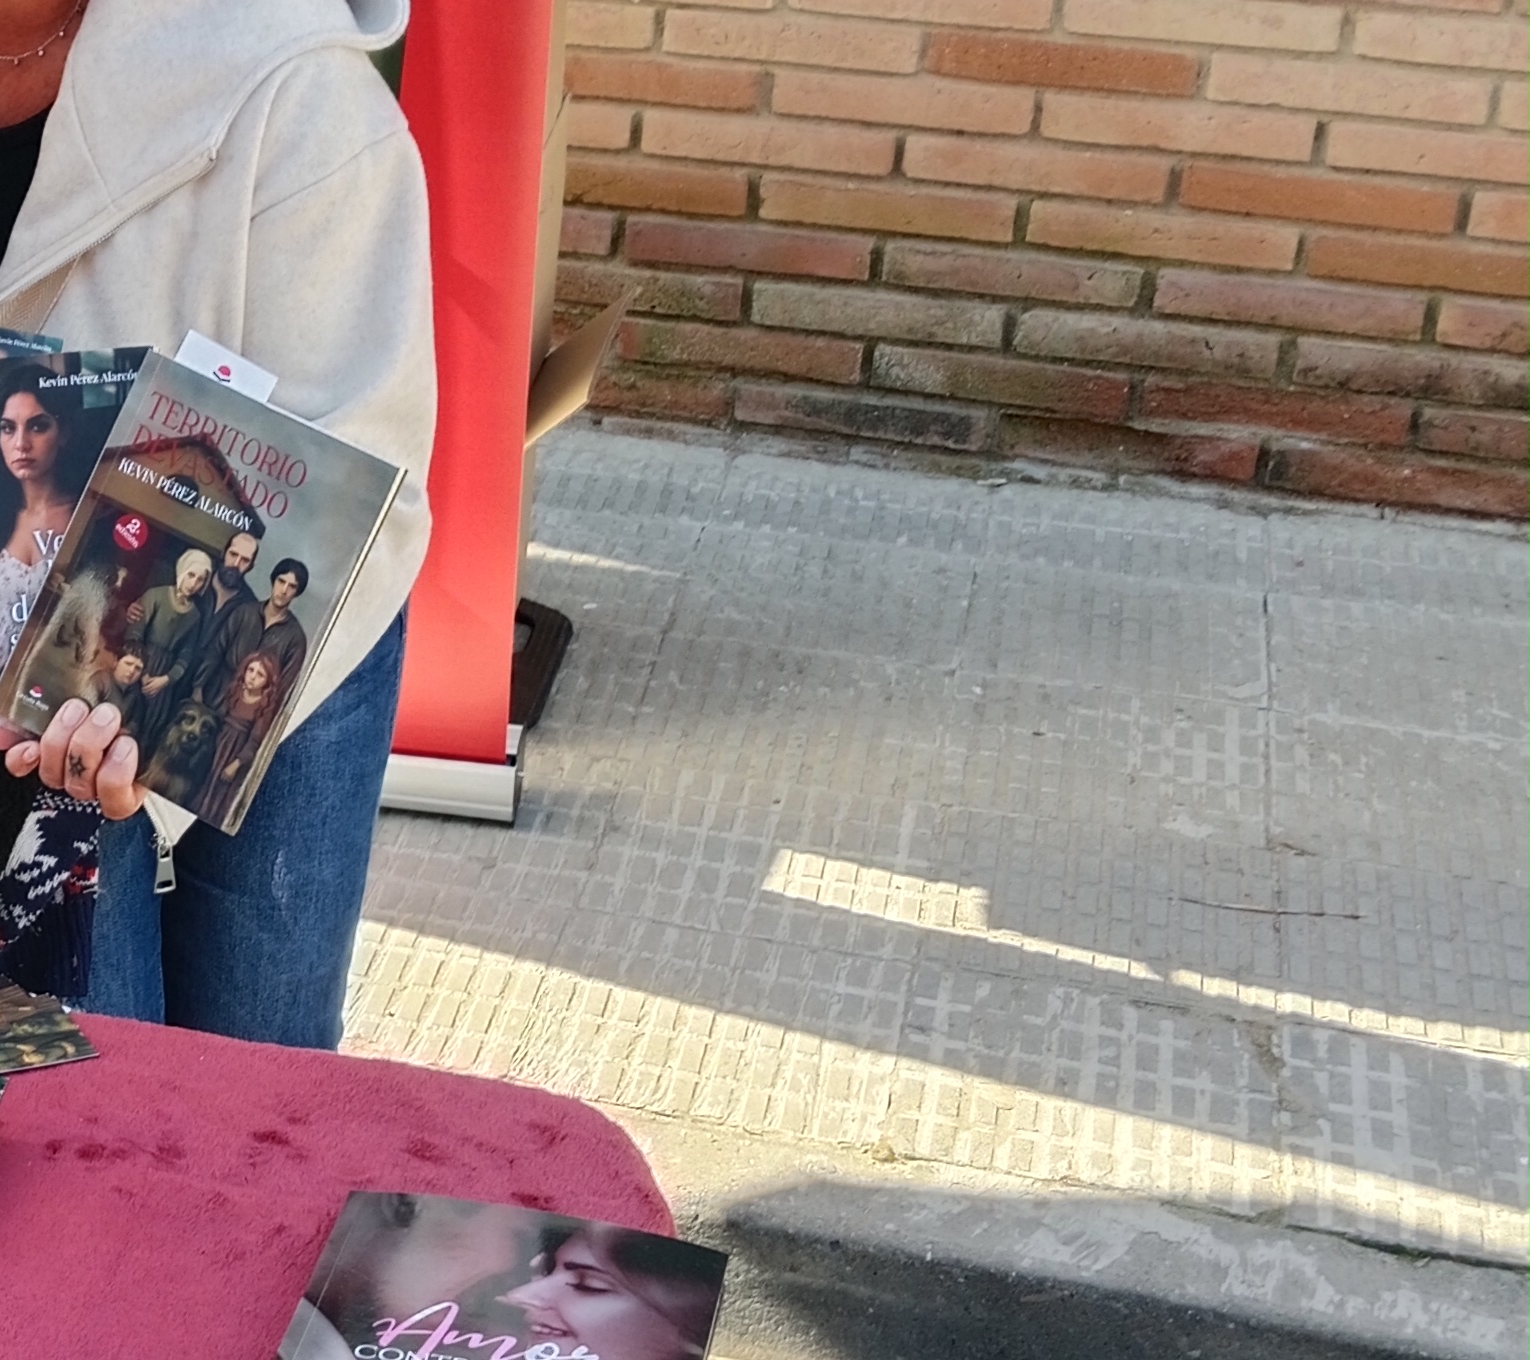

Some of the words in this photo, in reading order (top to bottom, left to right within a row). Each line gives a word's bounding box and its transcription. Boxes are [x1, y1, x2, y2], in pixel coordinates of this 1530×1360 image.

[38, 373, 68, 389] Kevin
[70, 371, 98, 386] Pérez
[147, 390, 307, 490] TERRITORIO
[117, 457, 156, 488] KEVIN
[156, 474, 197, 506] PÉREZ
[194, 493, 253, 532] ALARCÓN
